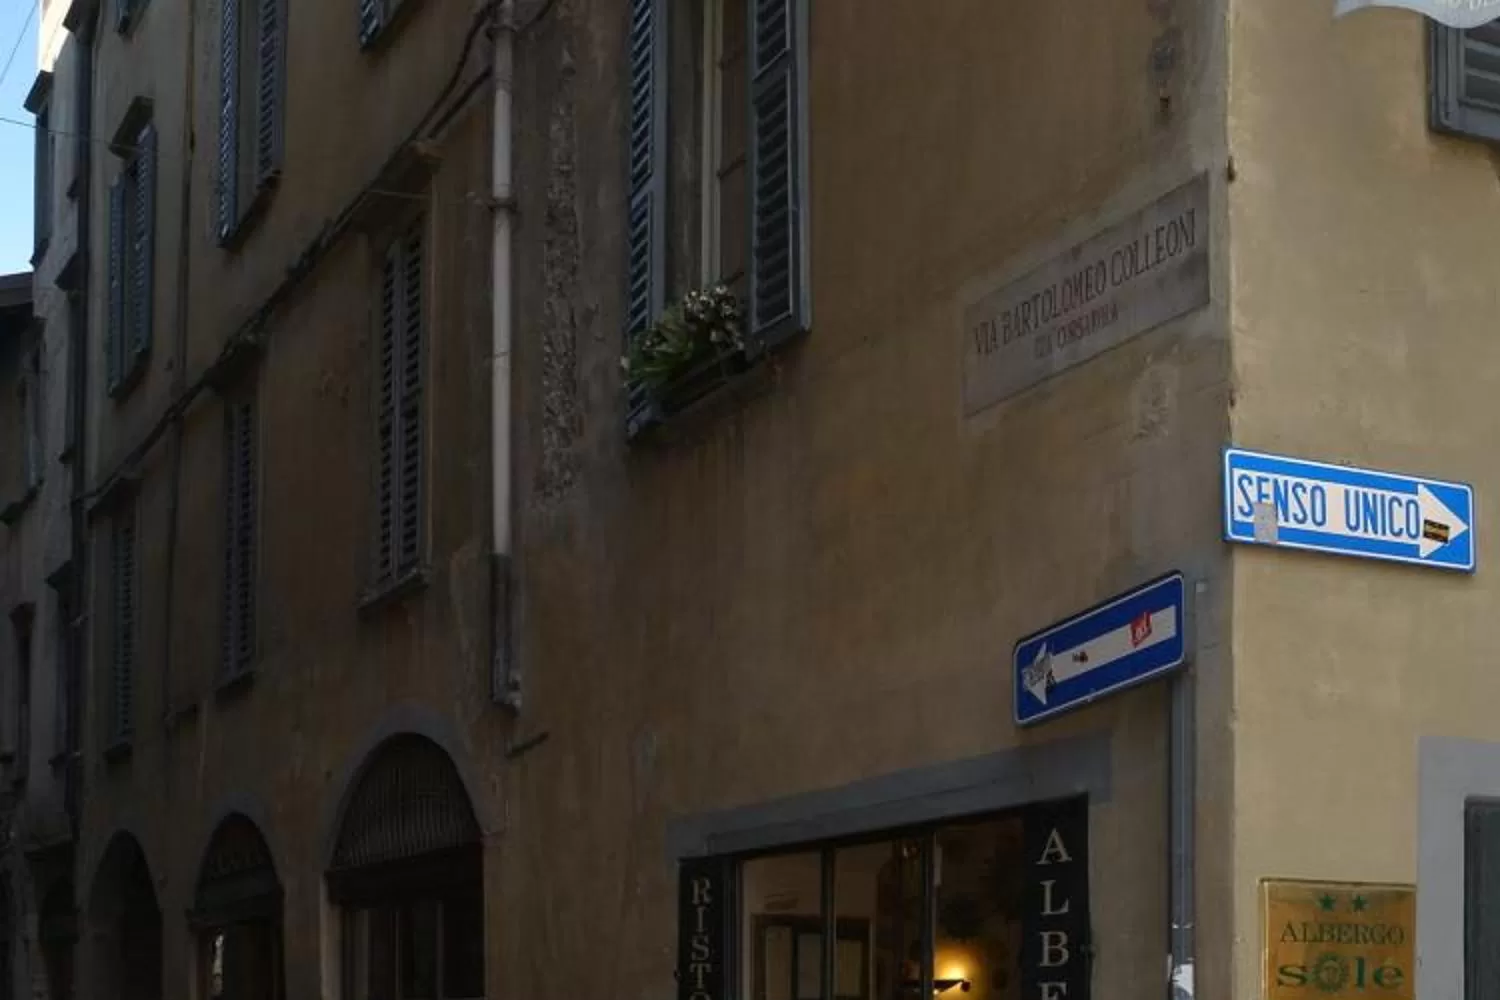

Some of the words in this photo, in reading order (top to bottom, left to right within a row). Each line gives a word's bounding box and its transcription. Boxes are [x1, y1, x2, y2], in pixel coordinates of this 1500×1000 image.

[974, 320, 999, 355] VIA
[1001, 260, 1107, 346] BARTOLOMEO
[1111, 207, 1196, 287] COLLEONI
[1238, 474, 1327, 527] SENSO
[1343, 487, 1420, 539] UNICO
[1279, 920, 1406, 945] ALBERGO
